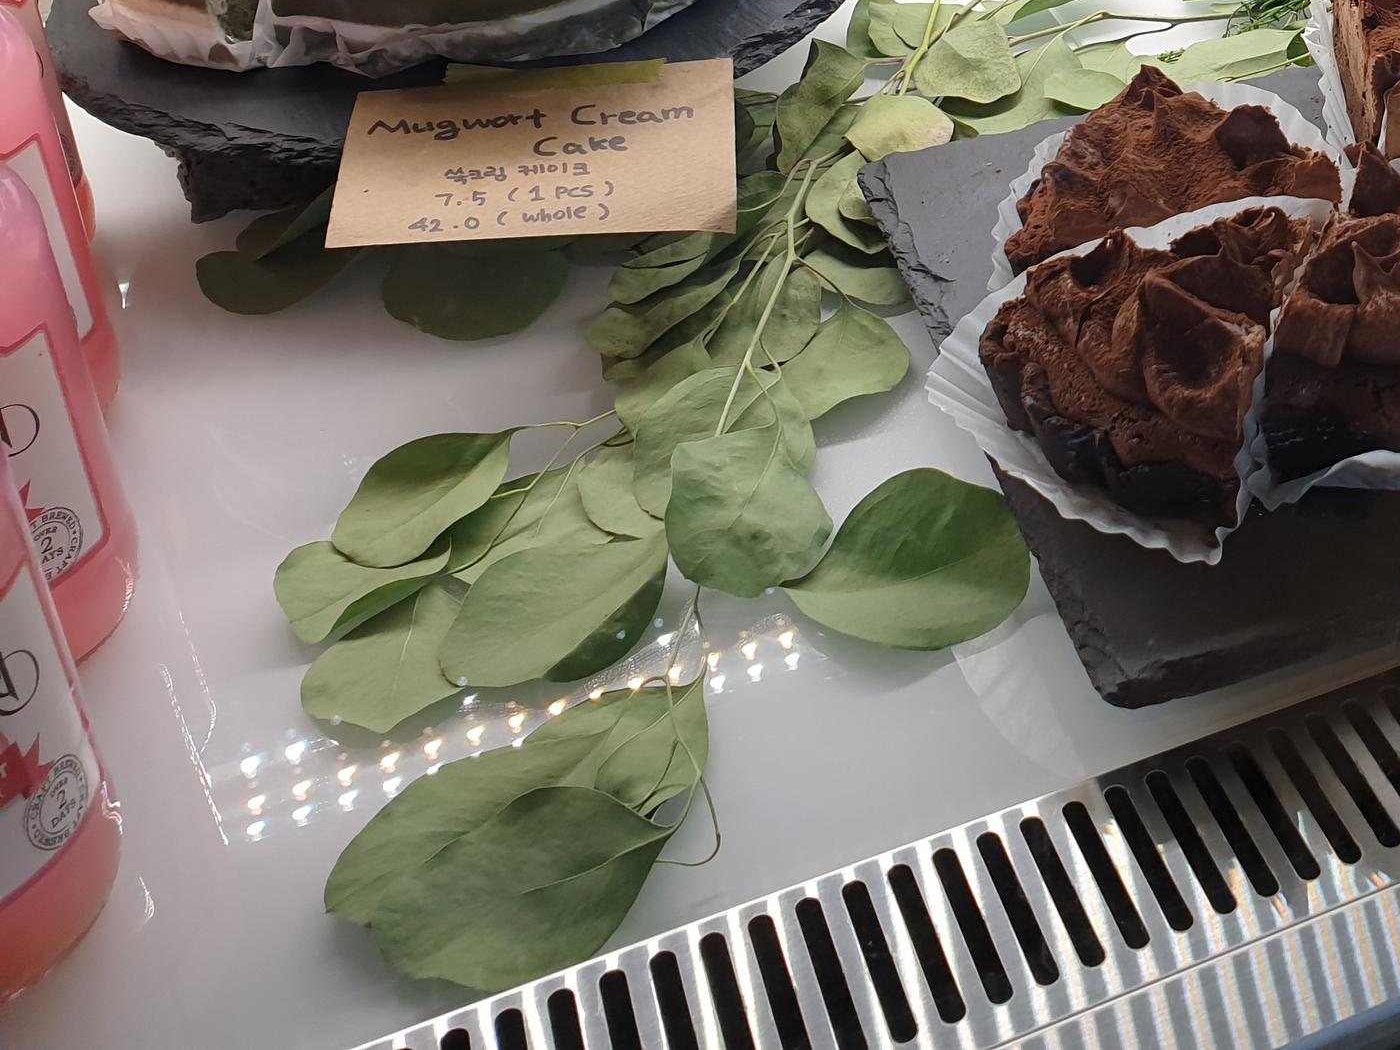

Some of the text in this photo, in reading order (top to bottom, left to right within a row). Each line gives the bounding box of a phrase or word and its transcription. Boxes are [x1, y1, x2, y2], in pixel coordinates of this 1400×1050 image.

[367, 103, 695, 142] Mugwort Cream
[532, 132, 629, 158] Cake
[517, 161, 591, 177] 케이크
[434, 189, 487, 207] 7.5
[407, 216, 481, 233] 42.0
[40, 536, 53, 554] 2
[41, 546, 64, 565] AYS
[56, 789, 67, 810] 2
